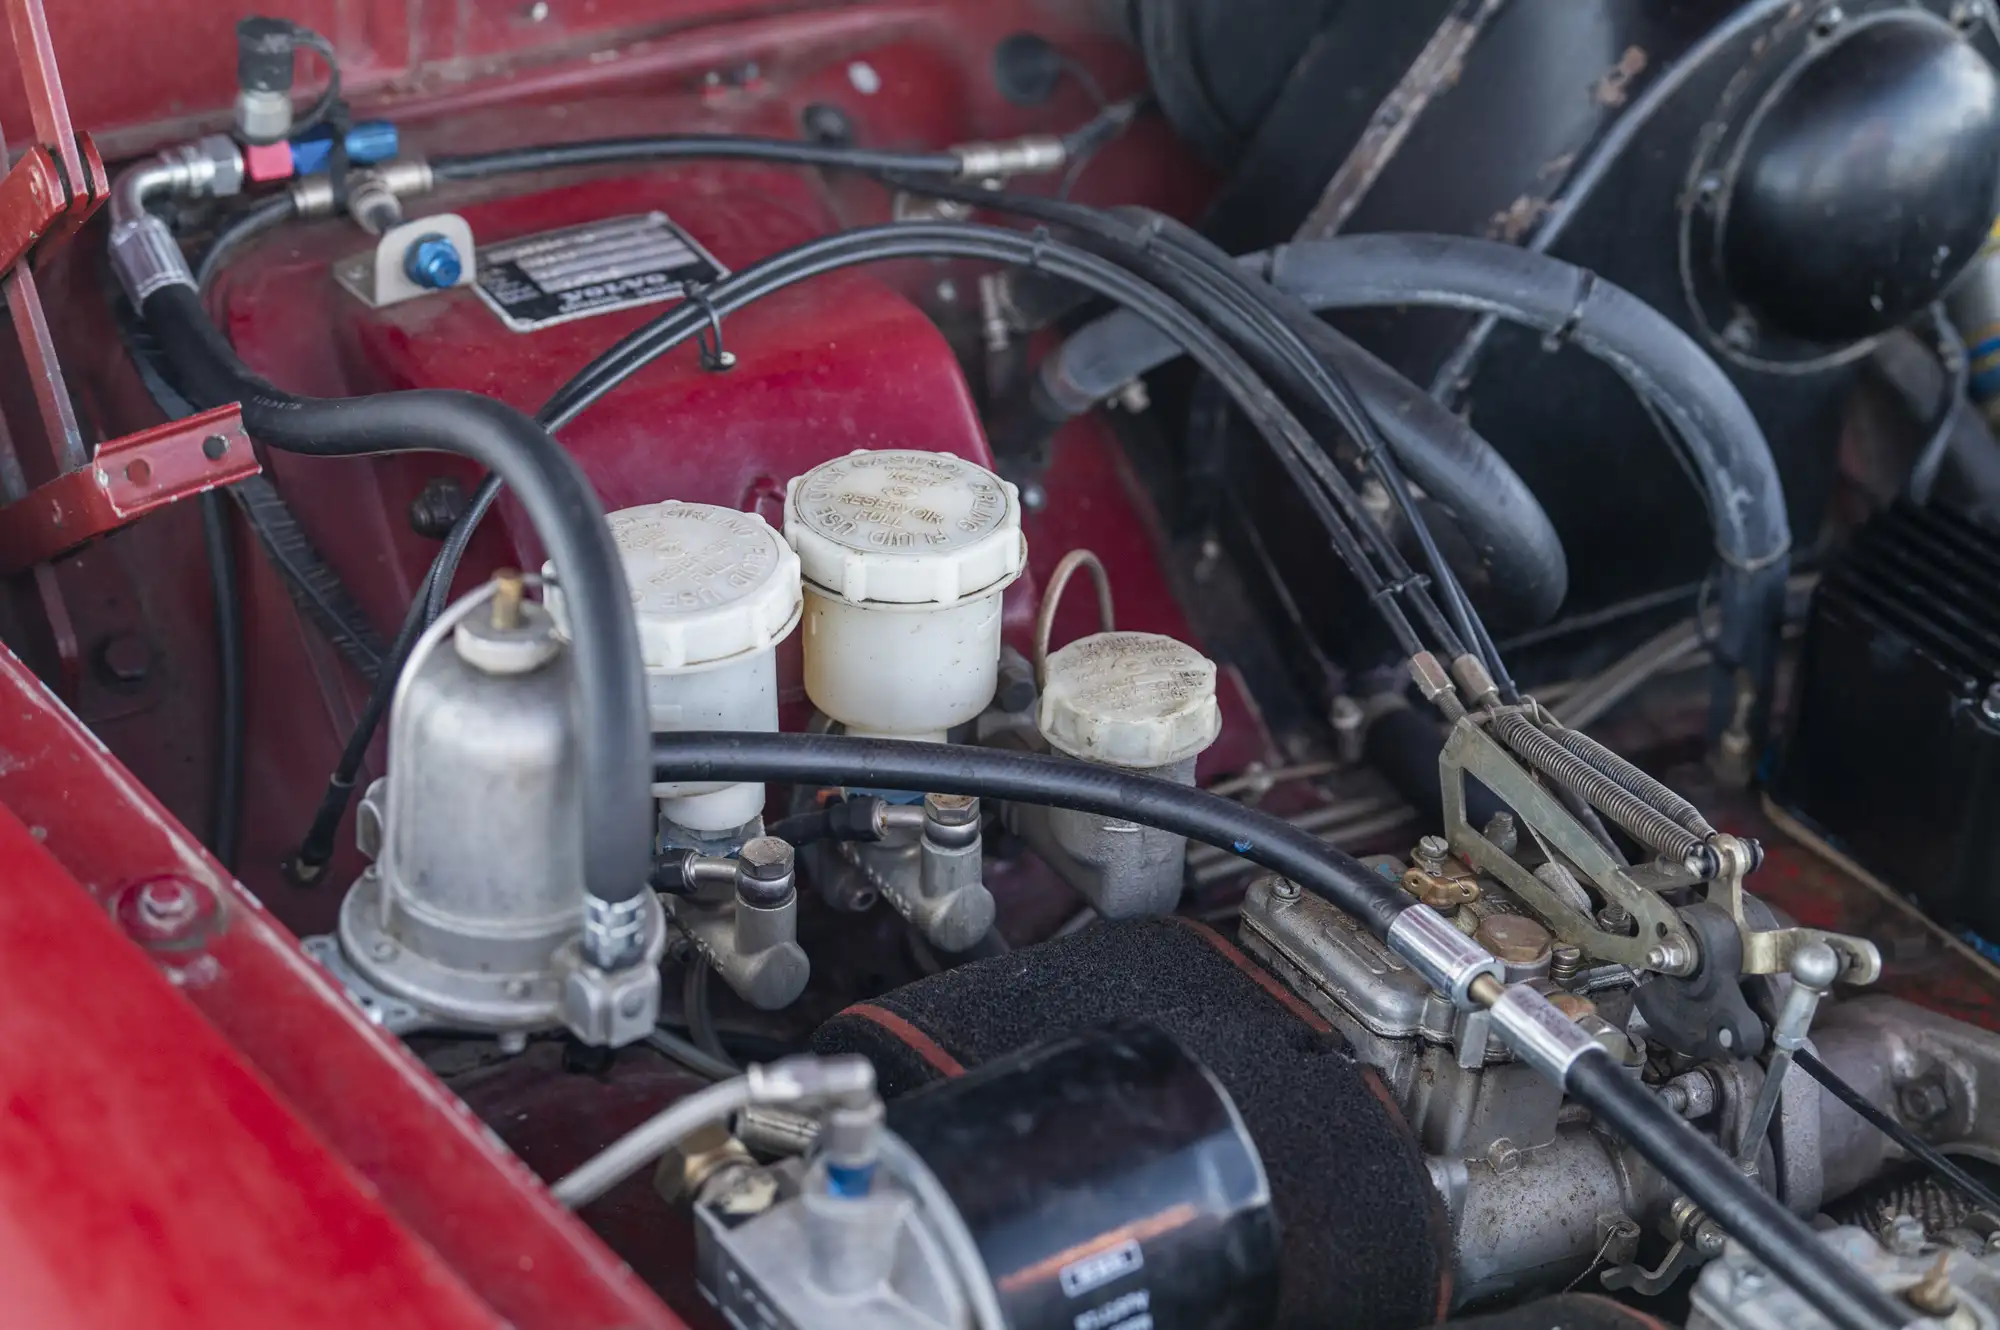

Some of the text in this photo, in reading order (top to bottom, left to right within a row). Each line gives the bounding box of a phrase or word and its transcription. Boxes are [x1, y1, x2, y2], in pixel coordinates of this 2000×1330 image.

[559, 273, 667, 301] VOLVO
[807, 467, 847, 502] ONLY
[811, 504, 858, 537] USE
[837, 493, 945, 525] RESERVOIR
[854, 508, 903, 529] FULL
[956, 482, 998, 533] GIRLING
[869, 528, 950, 547] FLUID
[687, 560, 737, 586] FULL
[660, 587, 724, 608] USE
